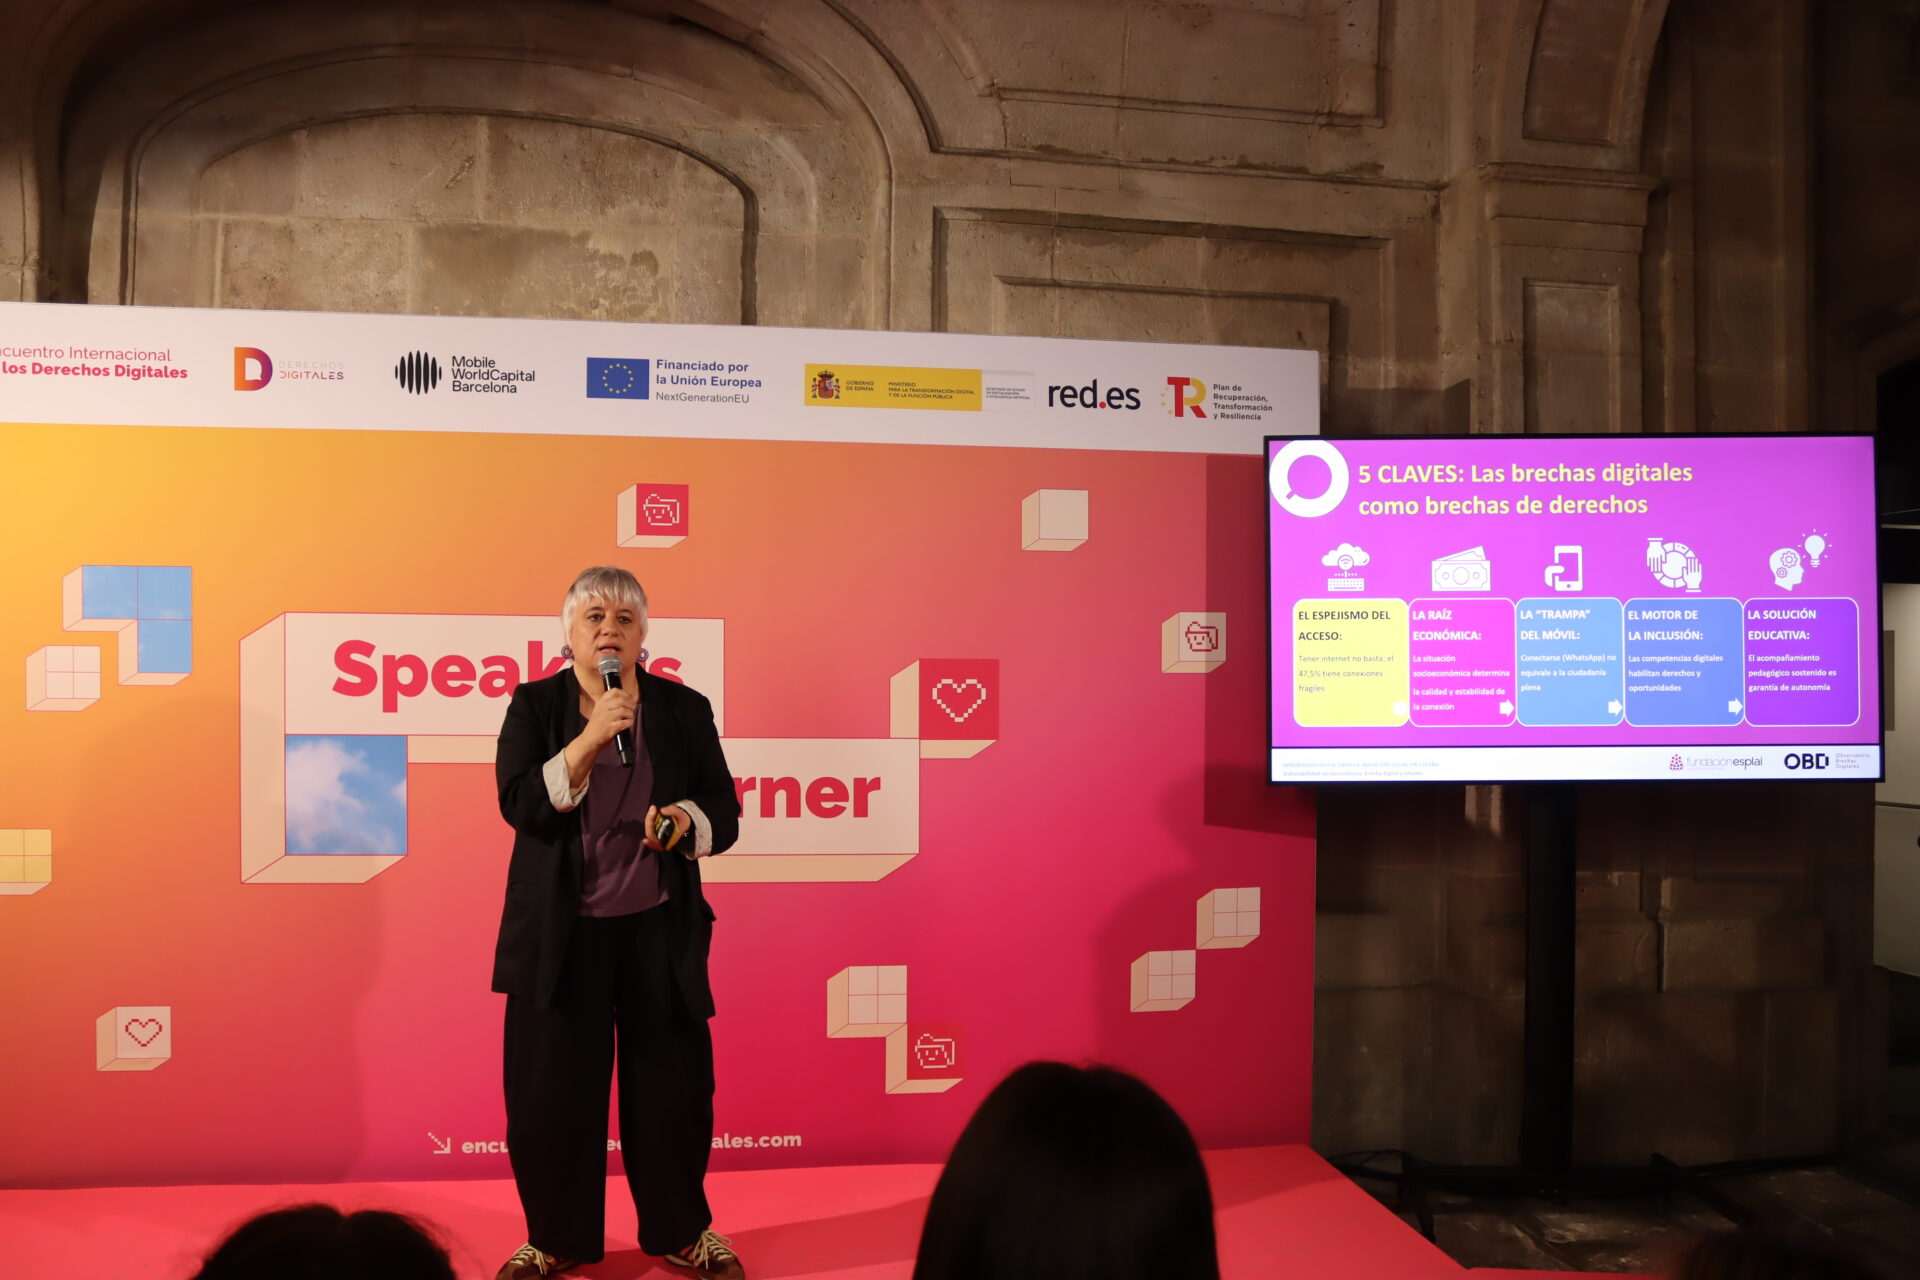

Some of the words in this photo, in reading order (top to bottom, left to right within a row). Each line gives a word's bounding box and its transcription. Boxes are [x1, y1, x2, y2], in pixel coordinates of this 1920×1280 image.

[69, 347, 171, 362] Internacional
[452, 356, 496, 369] Mobile
[656, 359, 724, 372] Financiado
[728, 362, 749, 375] por
[2, 361, 27, 375] los
[31, 362, 110, 377] Derechos
[114, 365, 188, 381] Digitales
[280, 370, 344, 380] DIGITALES
[452, 368, 535, 384] WorldCapital
[452, 380, 517, 394] Barcelona
[656, 375, 667, 385] la
[670, 375, 707, 387] Unión
[711, 377, 762, 390] Europea
[656, 392, 750, 404] NextGenerationEU
[1048, 378, 1141, 410] red.es
[1213, 393, 1268, 403] Recuperación,
[1213, 403, 1273, 412] Transformación
[1220, 412, 1262, 421] Resiliencia
[1359, 465, 1371, 483] 5
[1378, 465, 1464, 483] CLAVES:
[1471, 464, 1505, 482] Las
[1511, 463, 1596, 482] brechas
[1602, 463, 1693, 486] digitales
[1359, 499, 1419, 515] como
[1426, 496, 1510, 515] brechas
[1516, 496, 1543, 515] de
[1549, 495, 1648, 514] derechos
[1298, 611, 1310, 620] EL
[1312, 610, 1368, 621] ESPEJISMO
[1372, 610, 1391, 620] DEL
[1413, 611, 1426, 620] LA
[1428, 608, 1452, 620] RAÍZ
[1520, 610, 1533, 620] LA
[1628, 610, 1639, 620] EL
[1642, 610, 1682, 620] MOTOR
[1684, 610, 1698, 620] DE
[1748, 610, 1760, 619] LA
[1763, 608, 1816, 619] SOLUCIÓN
[1298, 631, 1342, 641] ACCESO:
[1413, 630, 1482, 641] ECONÓMICA:
[1520, 631, 1540, 640] DEL
[1542, 628, 1580, 640] MÓVIL:
[1628, 631, 1640, 640] LA
[1644, 628, 1704, 640] INCLUSIÓN:
[1748, 630, 1810, 640] EDUCATIVA:
[1521, 654, 1561, 662] Conectarse
[1562, 654, 1605, 663] (WhatsApp)
[1642, 654, 1692, 664] competencias
[1694, 654, 1723, 663] digitales
[1757, 654, 1820, 663] acompañamiento
[1521, 669, 1550, 678] equivale
[1749, 669, 1790, 678] pedagógico
[1521, 684, 1541, 692] plena
[1628, 684, 1681, 693] oportunidades
[1749, 684, 1778, 693] garantía
